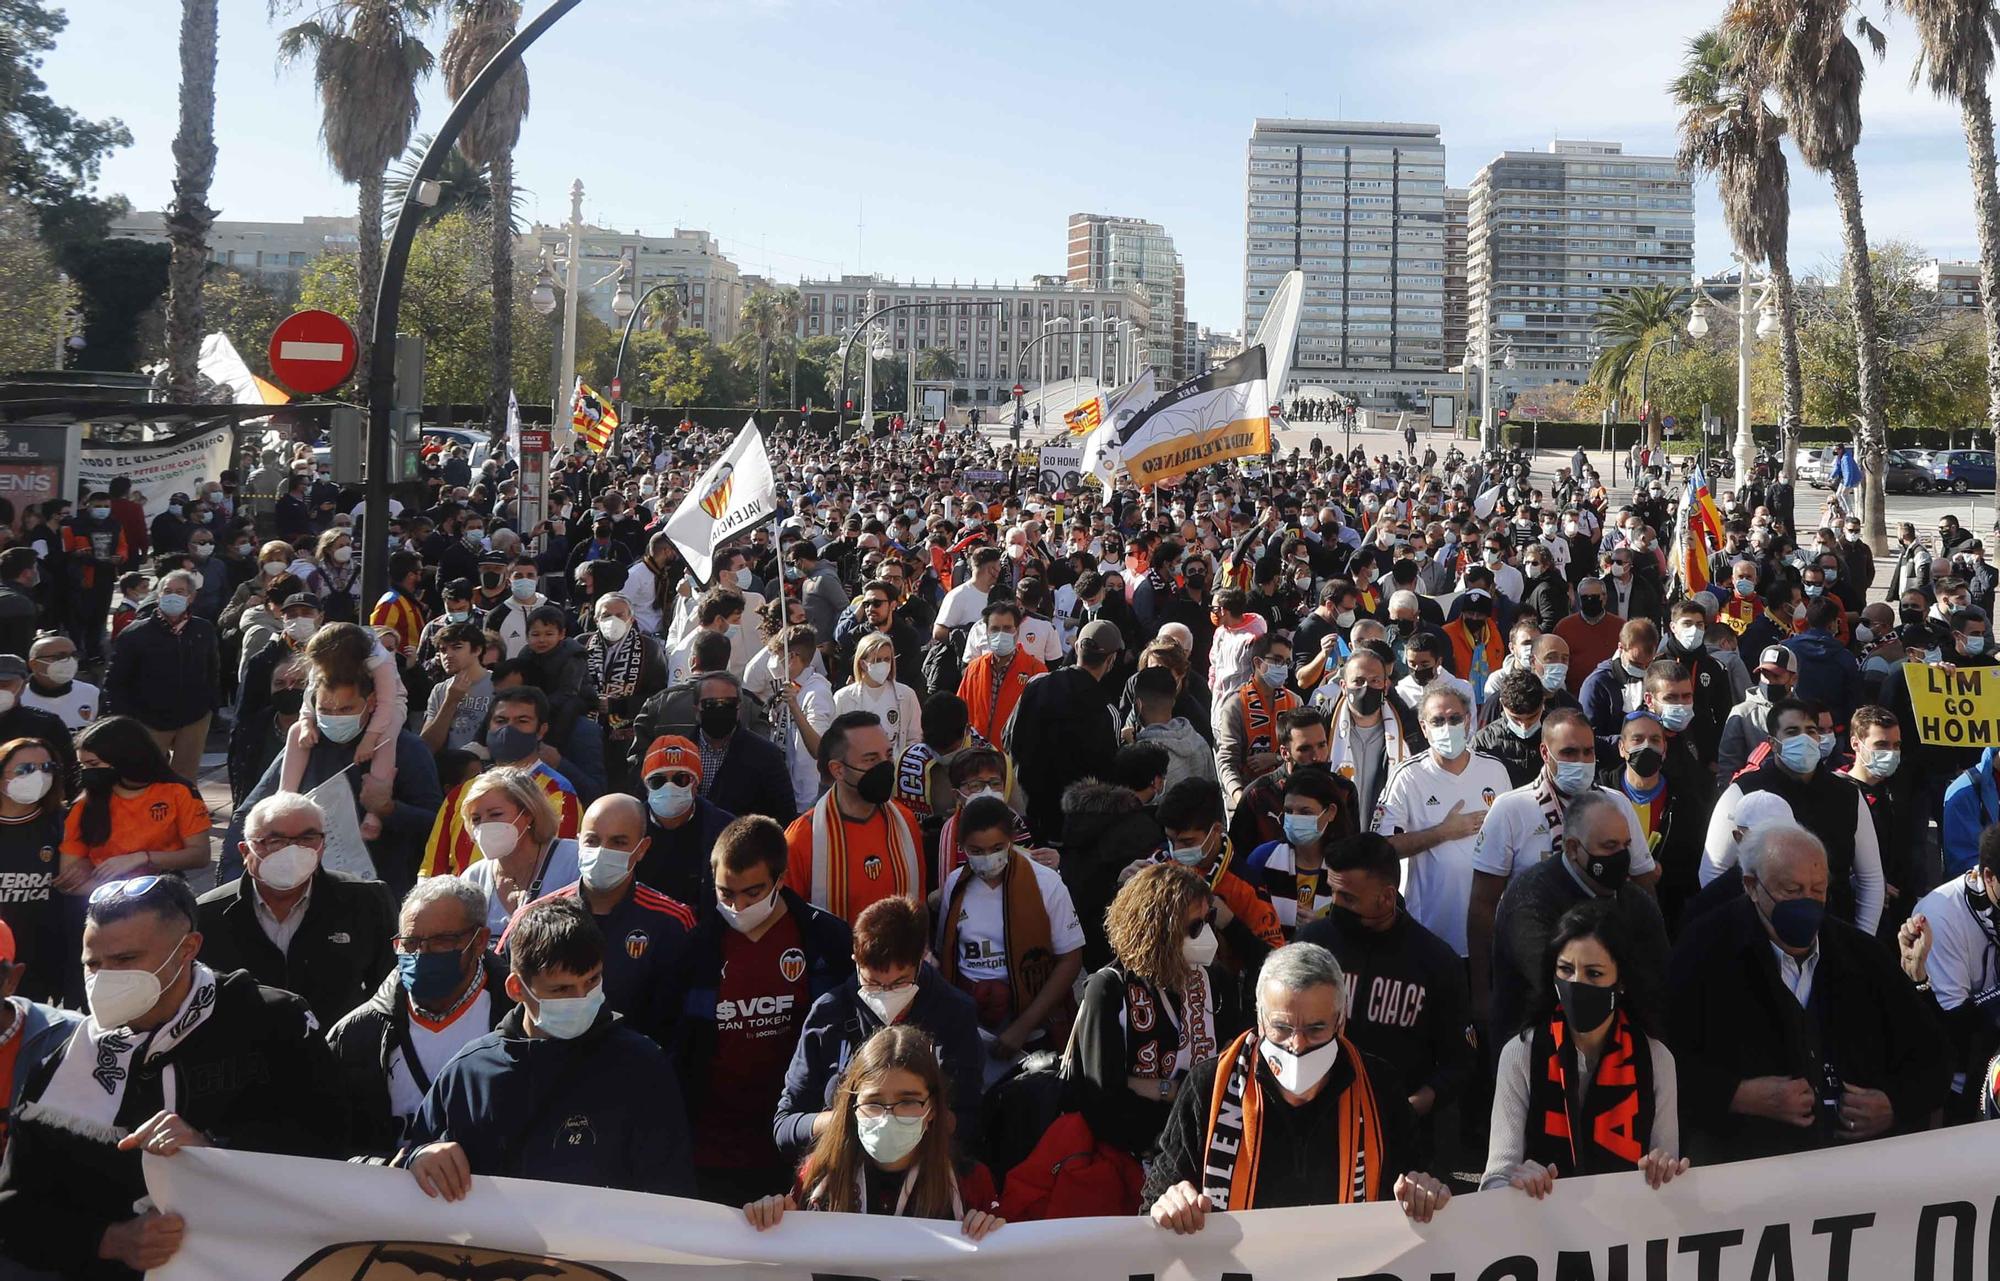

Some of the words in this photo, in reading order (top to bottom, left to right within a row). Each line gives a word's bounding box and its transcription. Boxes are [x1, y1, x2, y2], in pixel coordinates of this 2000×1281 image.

[116, 457, 131, 467] EL
[1043, 456, 1056, 466] GO
[1057, 457, 1080, 467] HOME
[631, 652, 641, 665] DE
[626, 667, 641, 696] CLUB
[1927, 667, 1982, 697] LIM
[1944, 698, 1975, 717] GO
[716, 995, 795, 1021] $VCF
[1129, 983, 1155, 1031] CF
[718, 1021, 743, 1031] FAN
[748, 1014, 791, 1028] TOKEN
[568, 1133, 582, 1145] 42
